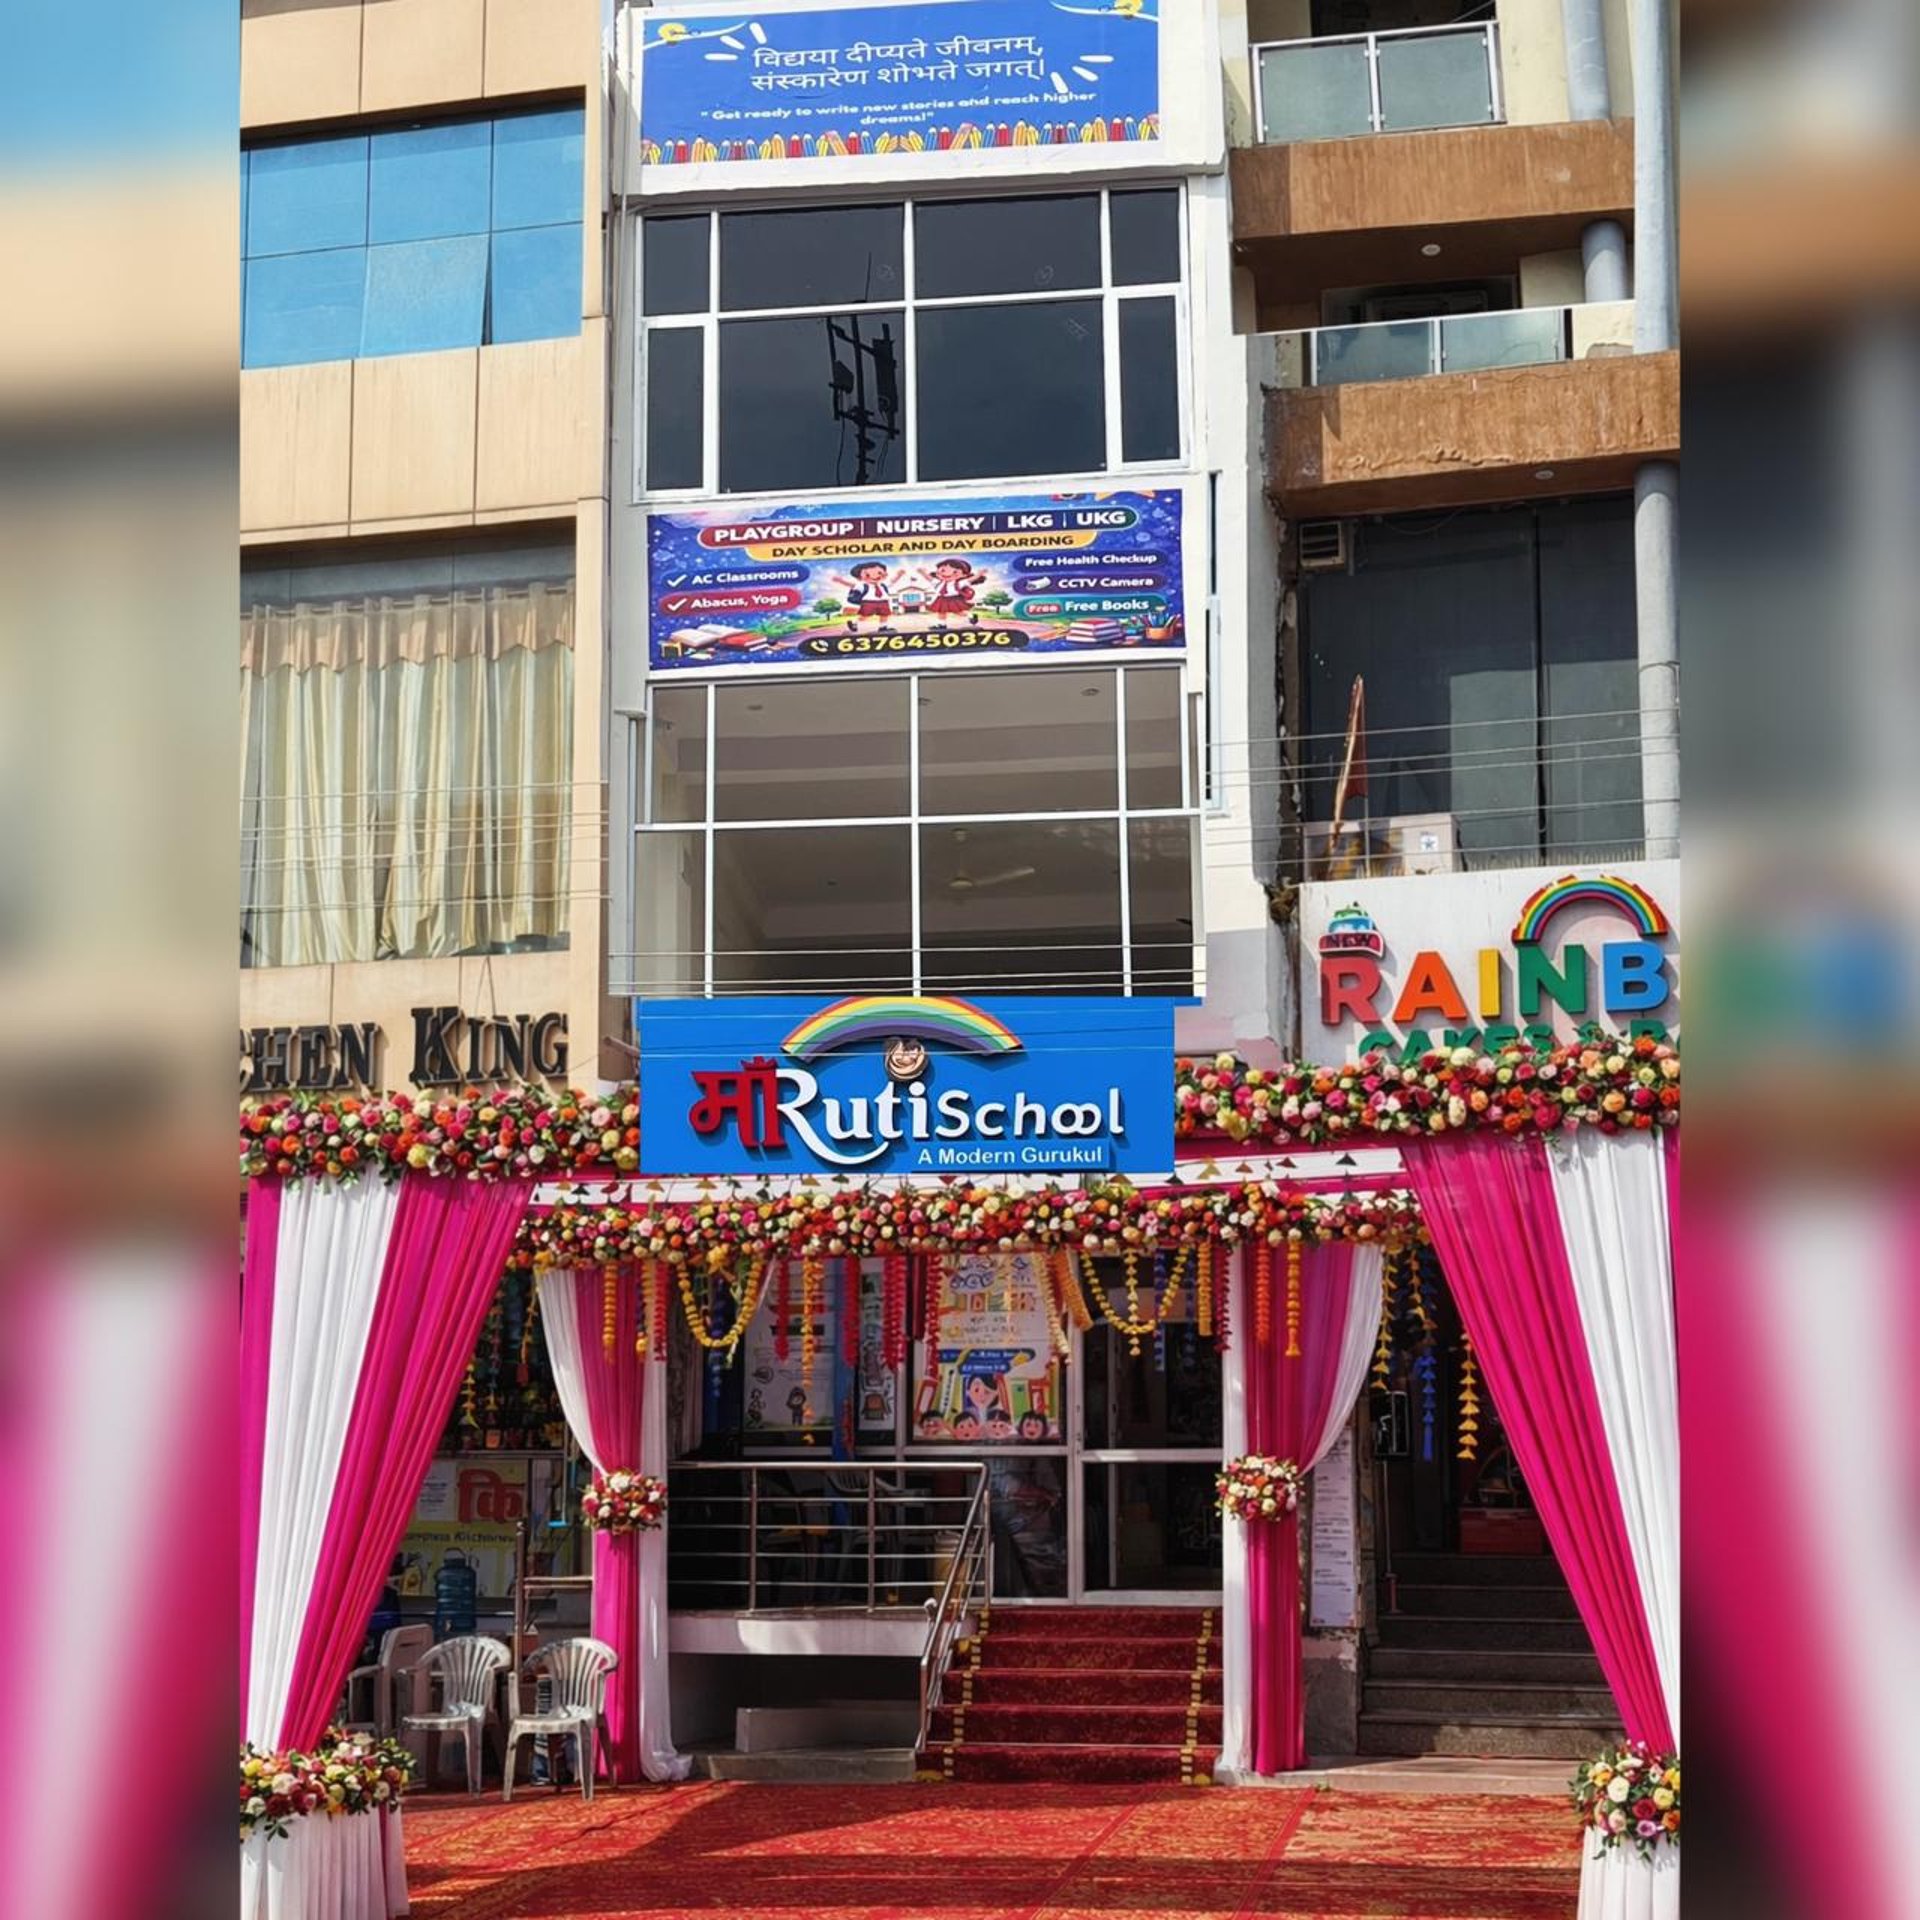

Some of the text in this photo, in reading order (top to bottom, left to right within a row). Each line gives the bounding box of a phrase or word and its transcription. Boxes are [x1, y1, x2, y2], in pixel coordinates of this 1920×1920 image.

[753, 47, 840, 68] विद्यया
[845, 38, 928, 63] दीप्यते
[751, 66, 869, 91] संस्कारेण
[877, 60, 958, 83] शोभते
[712, 110, 740, 120] Get
[744, 107, 791, 120] ready
[795, 107, 812, 116] to
[816, 104, 859, 115] write
[863, 103, 897, 112] new
[902, 101, 954, 110] stories
[958, 96, 989, 107] and
[994, 93, 1039, 105] reach
[1043, 91, 1097, 104] higher
[714, 511, 1127, 542] PLAYGROUP NURSERY LKG UKG
[772, 535, 1074, 558] DAY SCHOLAR AND DAY BOARDING
[1025, 553, 1157, 567] Free Health Checkup
[691, 569, 799, 585] AC Classrooms
[1058, 577, 1154, 589] CCTV Camera
[690, 594, 788, 609] Abacus, Yoga
[1028, 605, 1058, 613] Free
[1065, 599, 1149, 612] Free Books
[837, 631, 1011, 653] 6376450376
[1320, 941, 1669, 1026] RAINB
[934, 1086, 1124, 1138] School
[918, 1146, 1102, 1165] A Modern Gurukul
